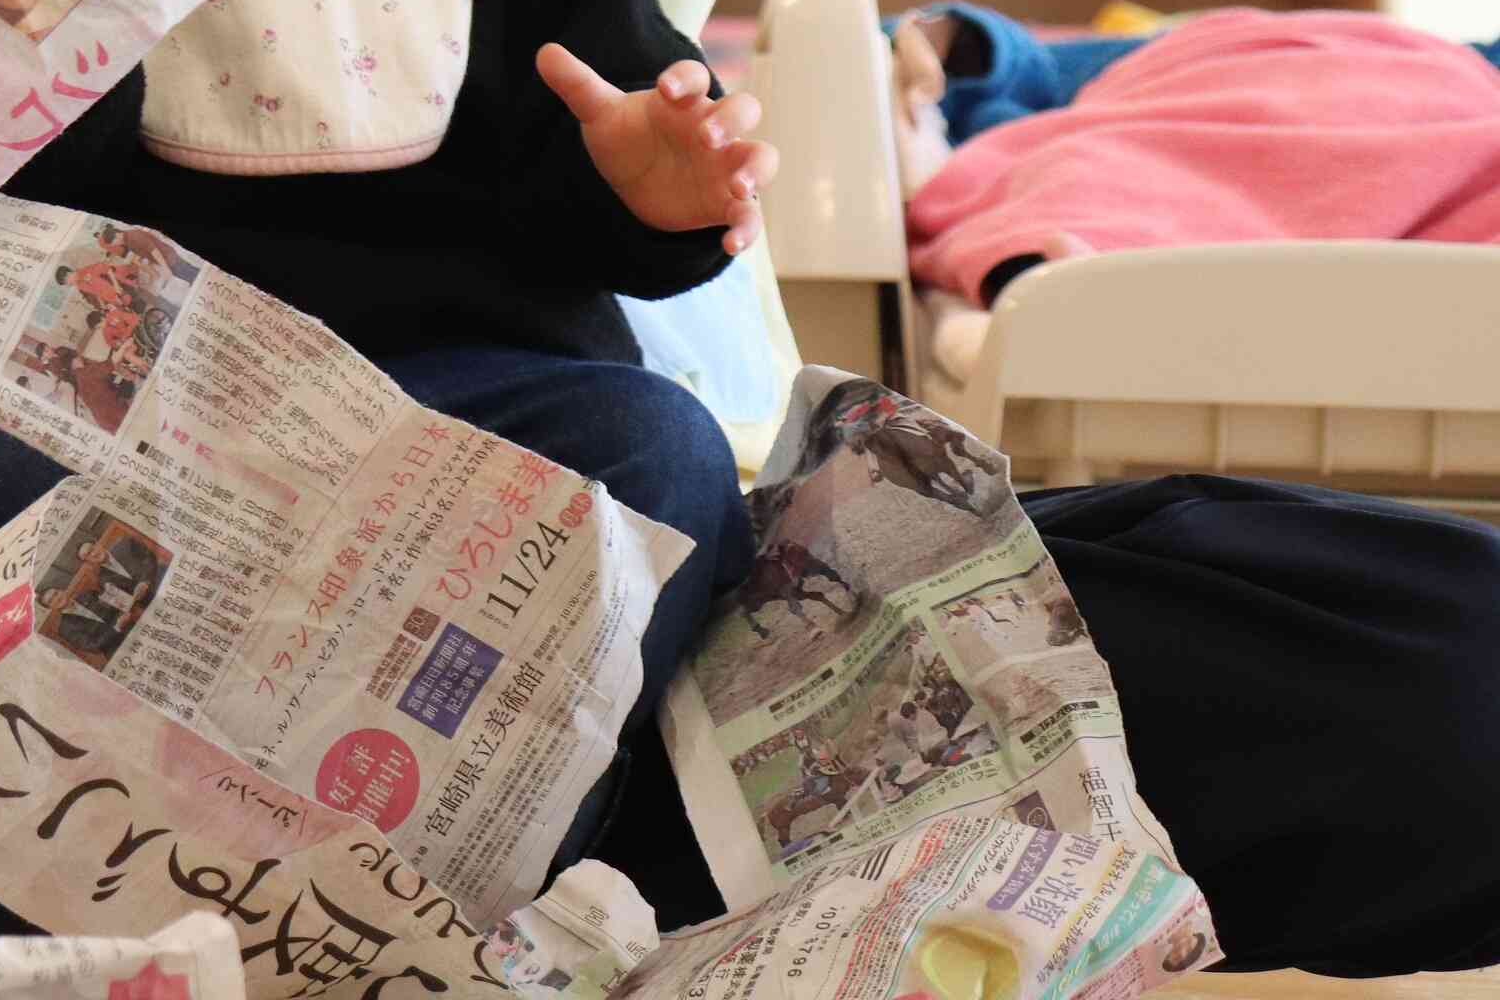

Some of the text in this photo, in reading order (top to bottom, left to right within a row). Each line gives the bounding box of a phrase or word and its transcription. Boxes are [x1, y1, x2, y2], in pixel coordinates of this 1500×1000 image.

[250, 415, 452, 706] フランス印象派から日本
[484, 514, 571, 621] 11/24
[421, 658, 546, 841] 宮崎県立美術館
